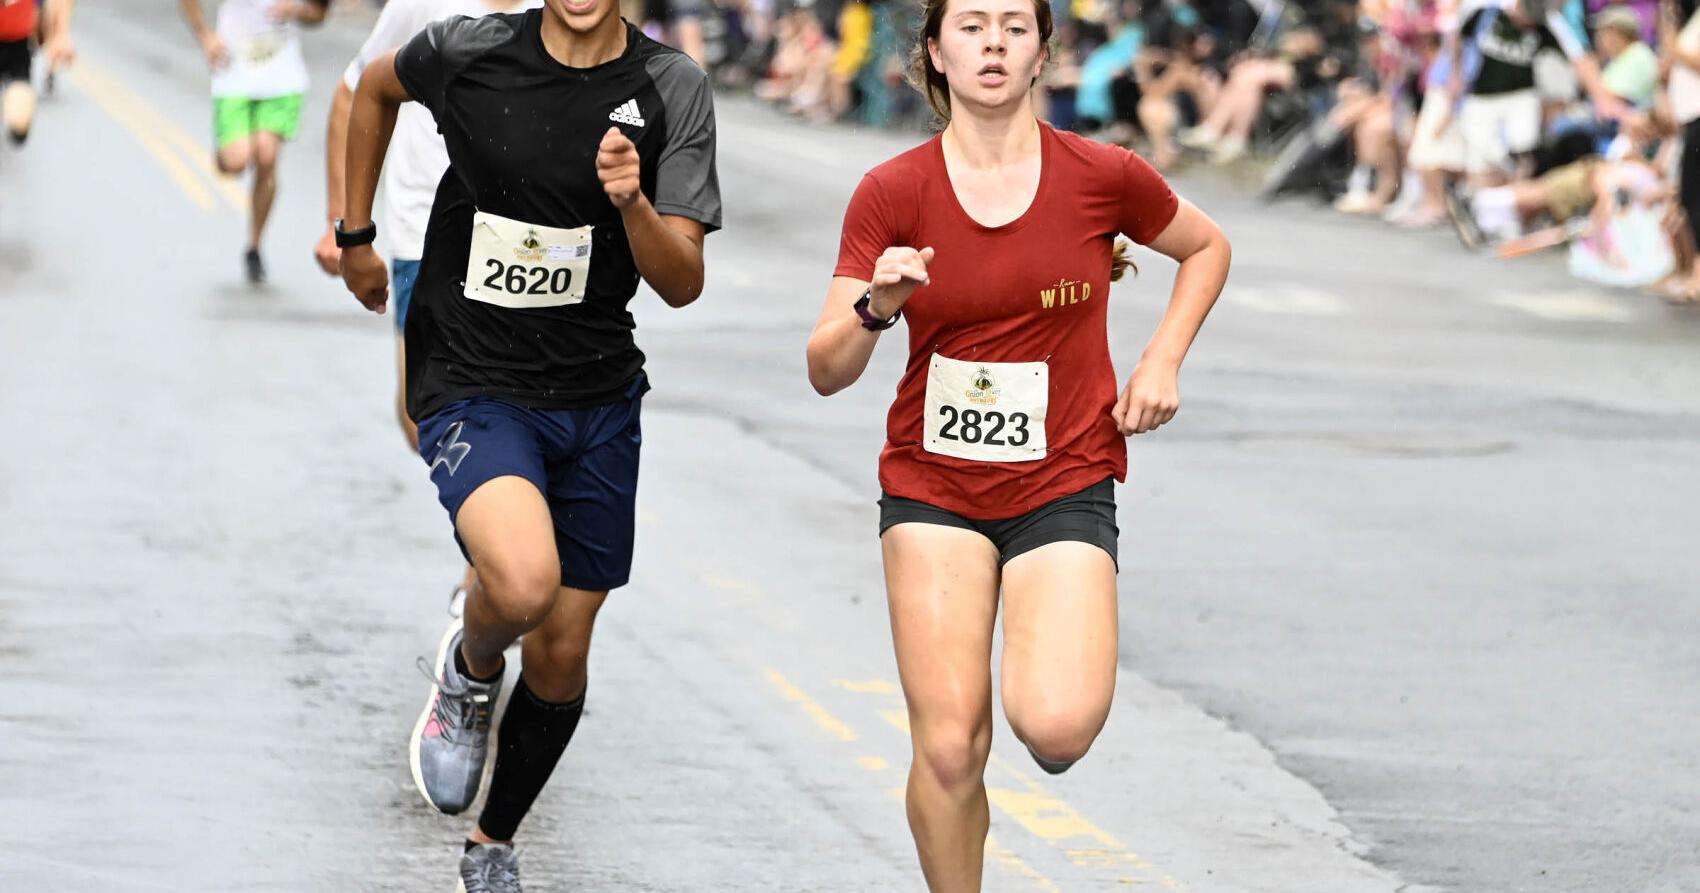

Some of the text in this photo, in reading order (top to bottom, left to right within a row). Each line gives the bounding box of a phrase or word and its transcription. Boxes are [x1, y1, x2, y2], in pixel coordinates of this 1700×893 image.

[609, 111, 645, 127] adidas
[483, 258, 572, 295] 2620
[1040, 282, 1090, 309] WILD
[939, 404, 1029, 446] 2823
